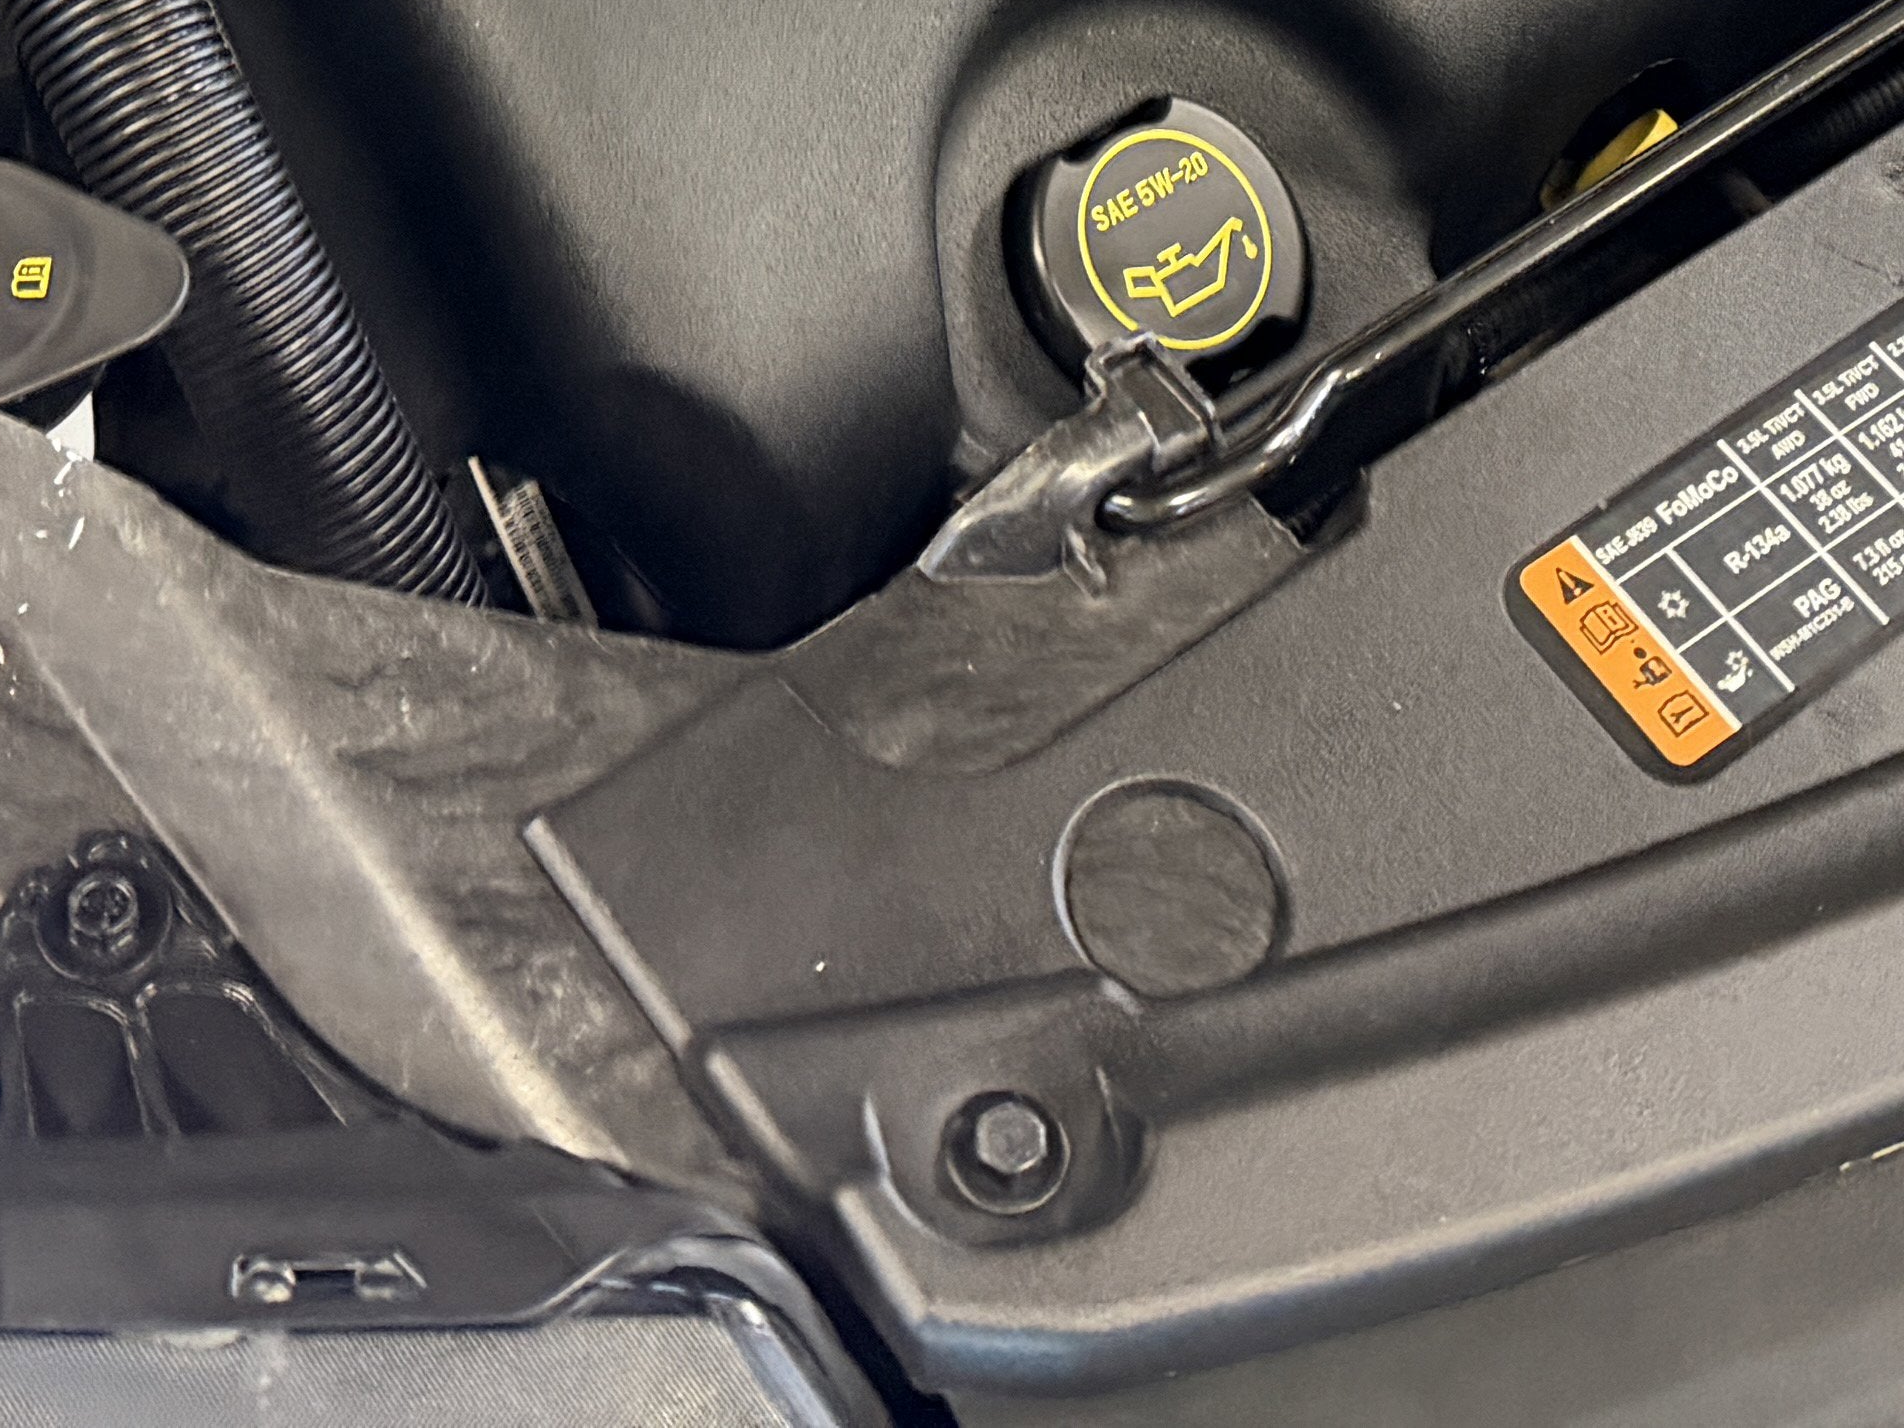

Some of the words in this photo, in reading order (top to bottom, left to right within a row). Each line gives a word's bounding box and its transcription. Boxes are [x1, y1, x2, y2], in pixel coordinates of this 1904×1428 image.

[1091, 188, 1139, 232] SAE
[1135, 151, 1209, 208] 5W-20
[1771, 429, 1806, 460] AWD
[1858, 413, 1904, 451] 1.162
[1780, 462, 1824, 503] 1.077
[1818, 452, 1852, 477] kg
[1830, 479, 1852, 499] oz
[1595, 535, 1629, 565] SAE
[1655, 465, 1739, 525] FoMoCo
[1845, 491, 1875, 515] lbs
[1722, 524, 1791, 574] R-134a
[1852, 546, 1881, 571] 7.3
[1872, 556, 1903, 586] 215
[1792, 577, 1842, 618] PAG
